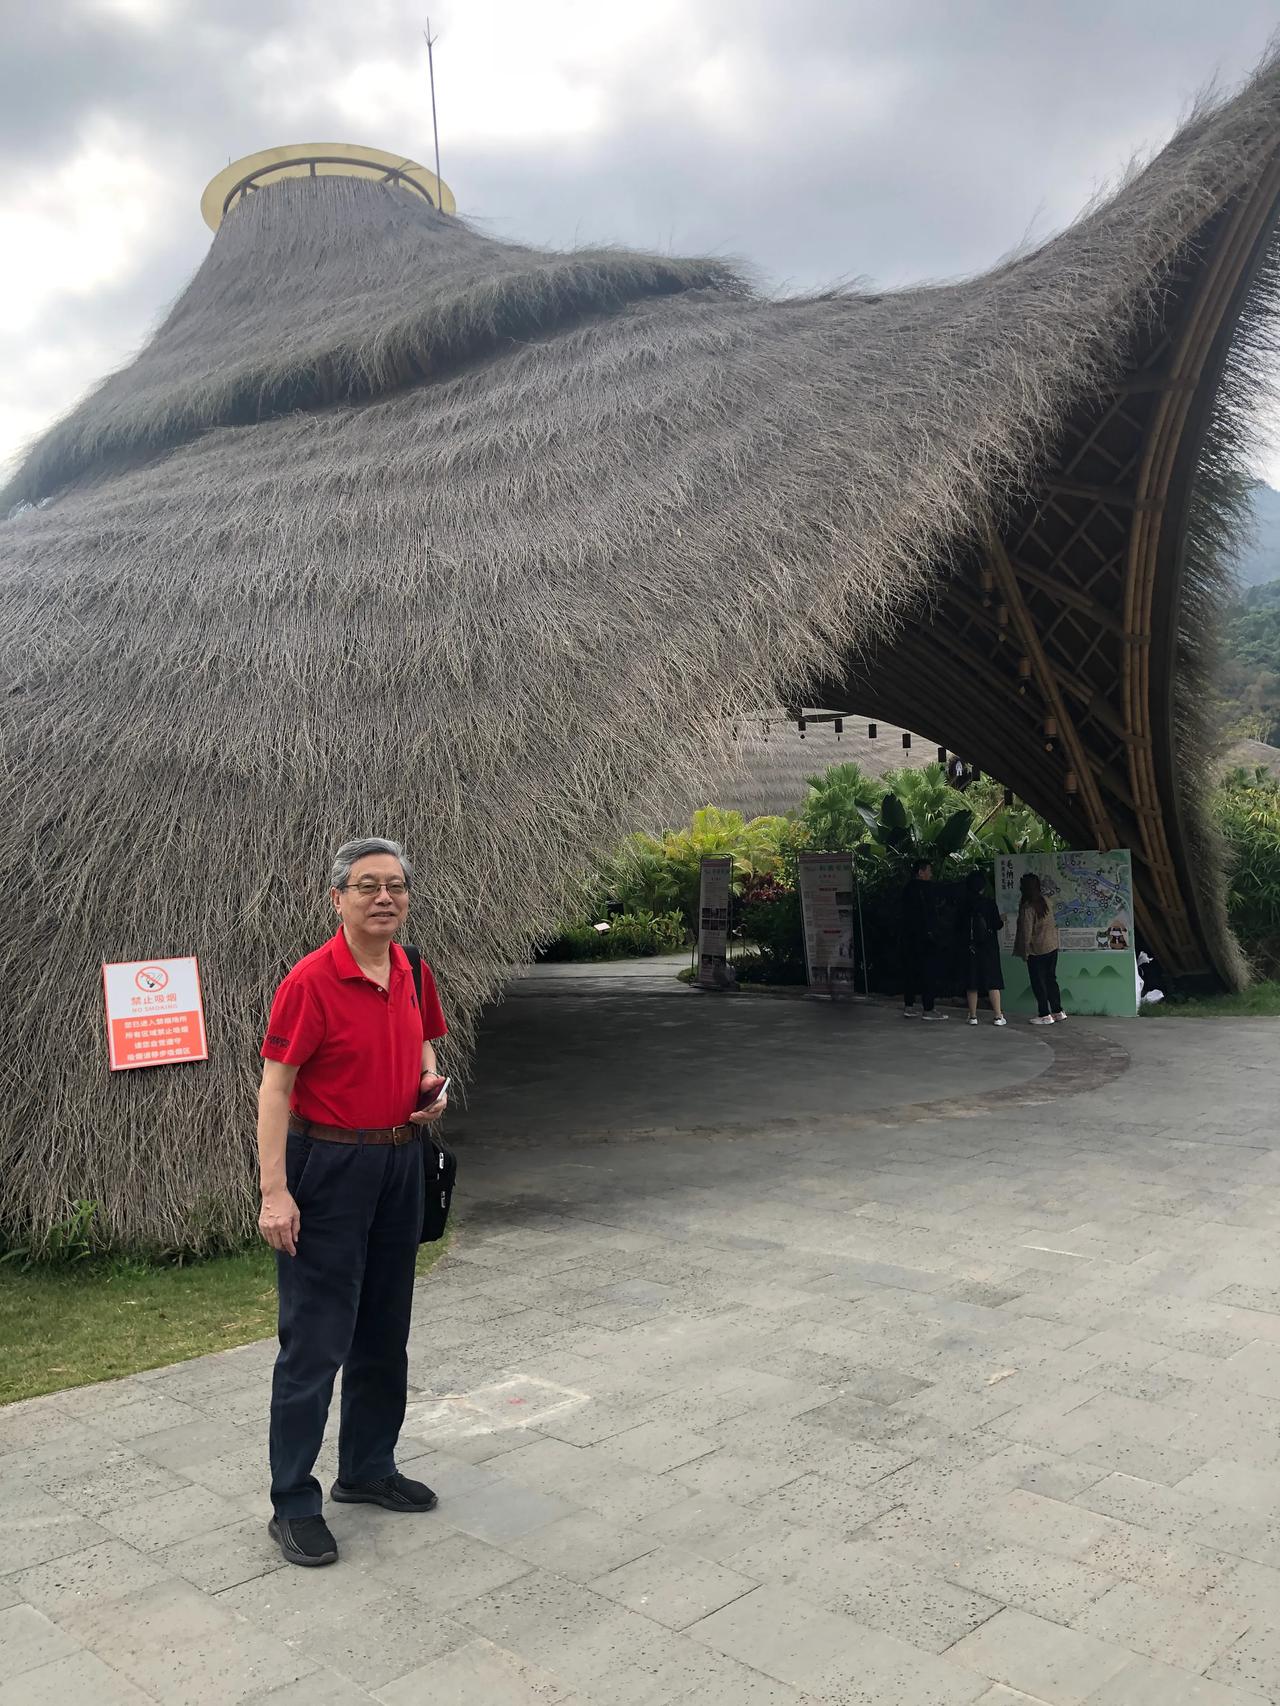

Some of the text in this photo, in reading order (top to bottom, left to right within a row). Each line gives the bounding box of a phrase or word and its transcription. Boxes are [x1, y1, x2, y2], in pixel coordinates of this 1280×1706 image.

[130, 993, 177, 1006] 禁止吸烟
[144, 1004, 178, 1012] SMOKING
